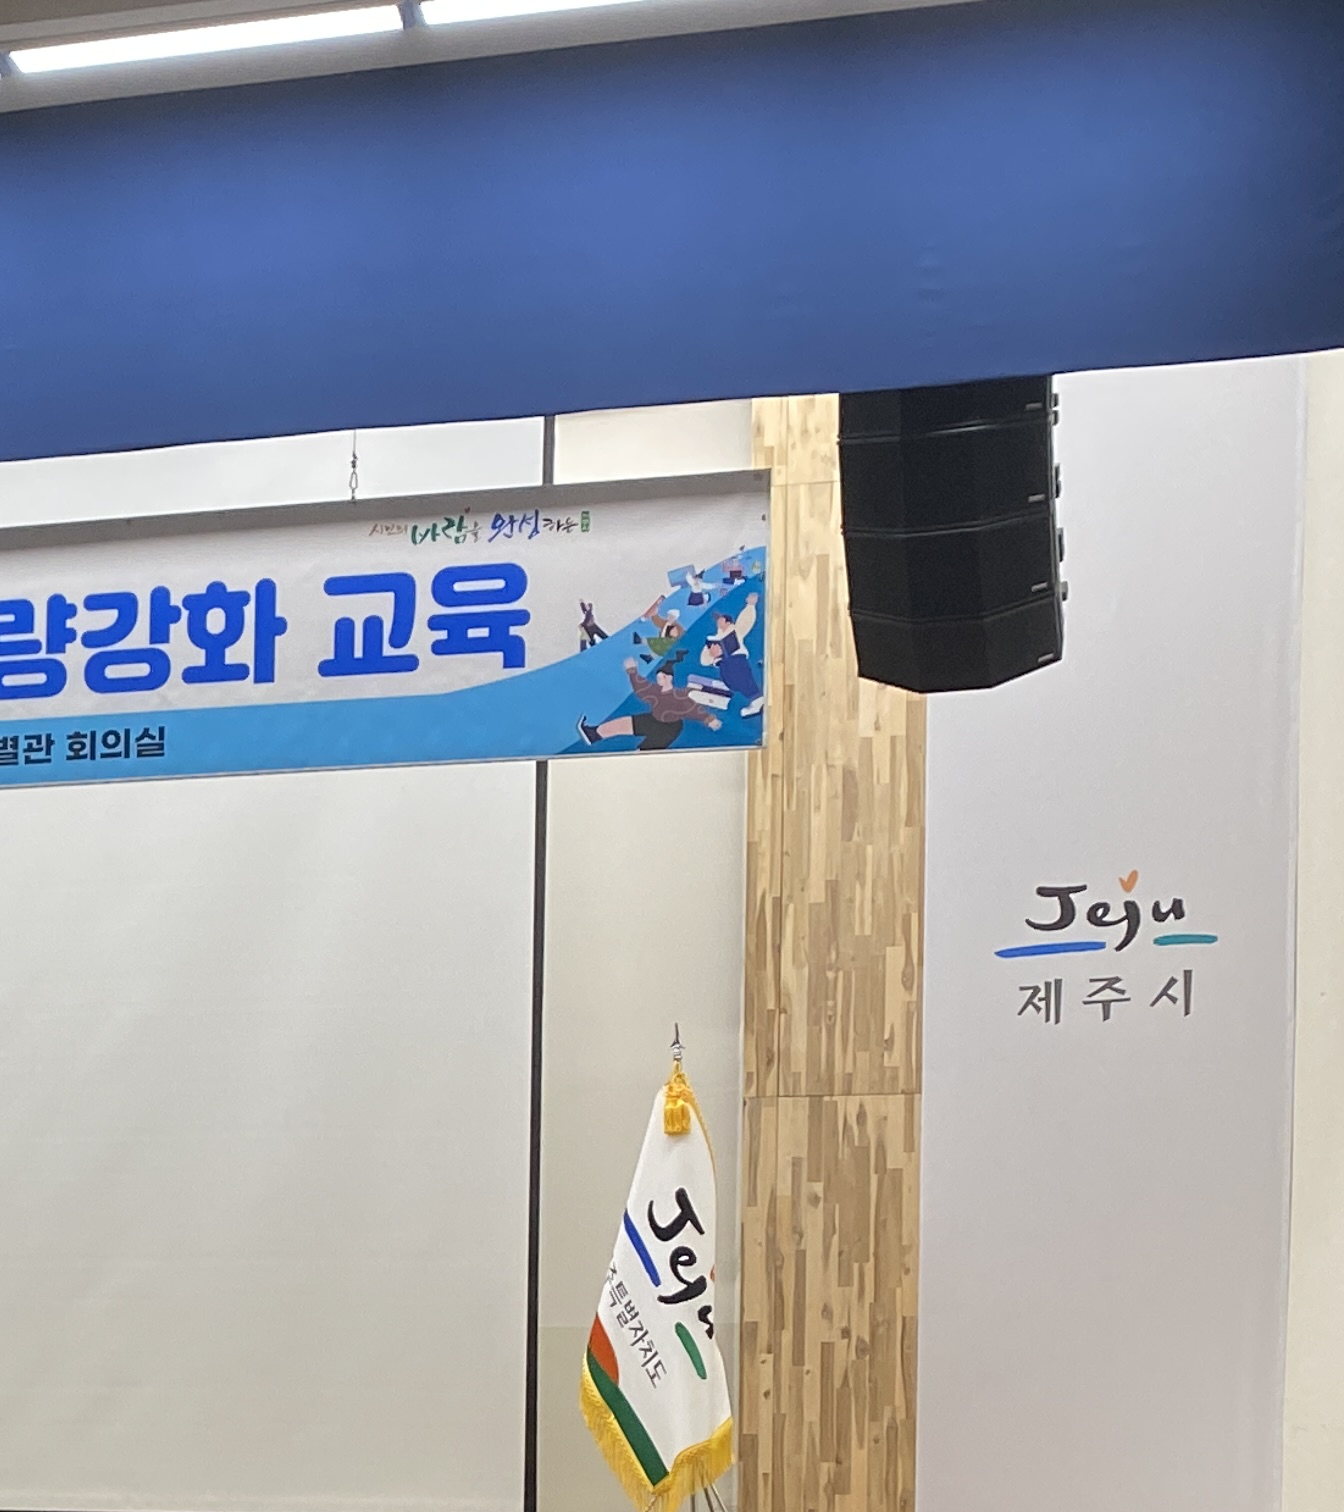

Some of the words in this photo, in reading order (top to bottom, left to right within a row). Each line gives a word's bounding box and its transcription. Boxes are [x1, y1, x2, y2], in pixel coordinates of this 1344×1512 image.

[317, 563, 531, 678] 교육
[65, 726, 167, 761] 회의실
[1024, 869, 1186, 952] Jeju
